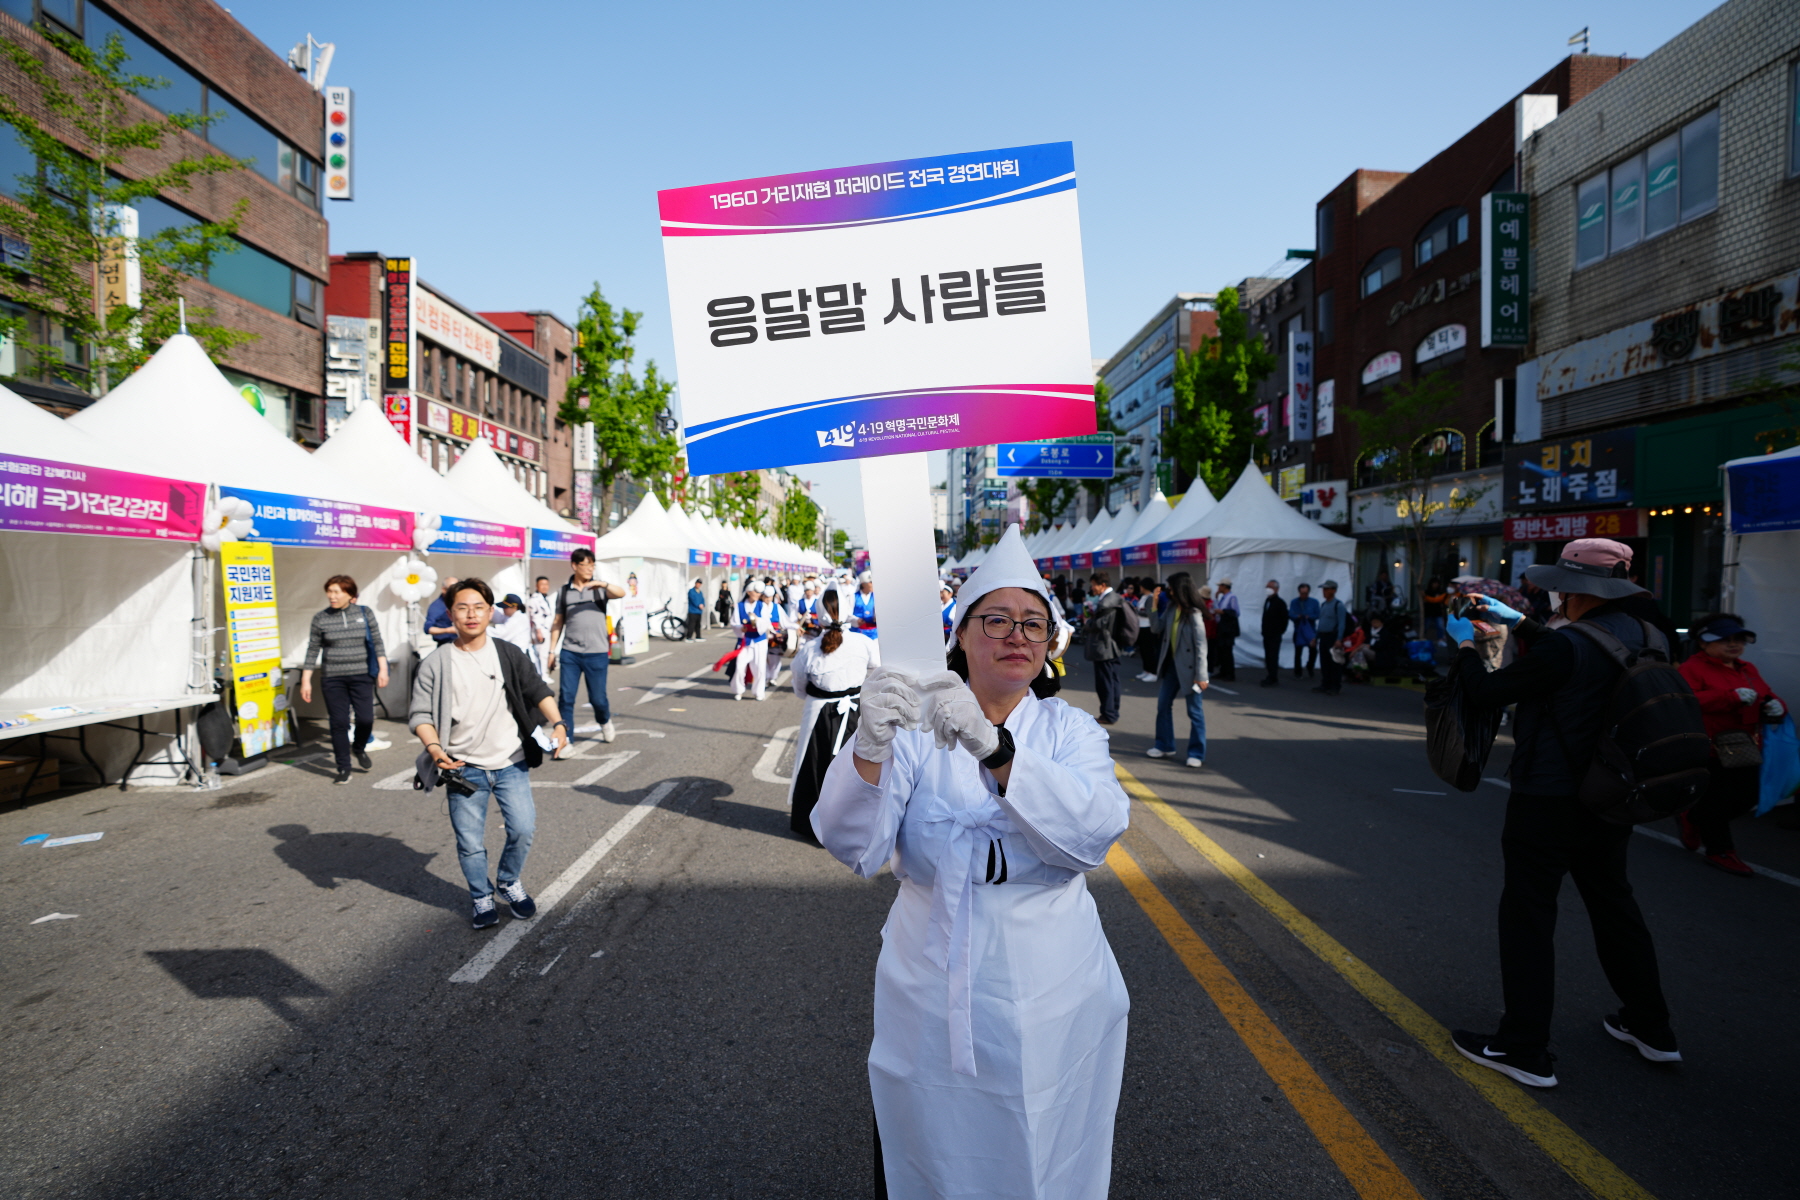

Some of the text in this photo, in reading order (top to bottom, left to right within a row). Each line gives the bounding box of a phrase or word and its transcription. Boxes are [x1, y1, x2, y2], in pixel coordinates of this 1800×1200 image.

[709, 159, 1020, 210] 1960 거리재현 퍼레이드 전국 경연대회
[1494, 199, 1525, 214] The
[706, 262, 1047, 348] 응달말 사람들
[885, 413, 960, 432] 혁명국민문화제
[1040, 447, 1070, 459] 도봉로
[1541, 439, 1593, 471] 리치
[1518, 468, 1618, 505] 노래주점
[42, 487, 168, 522] 국가건강검진
[1512, 514, 1621, 540] 쟁반노래방 2층
[227, 565, 272, 582] 국민취업
[229, 585, 274, 602] 지원제도
